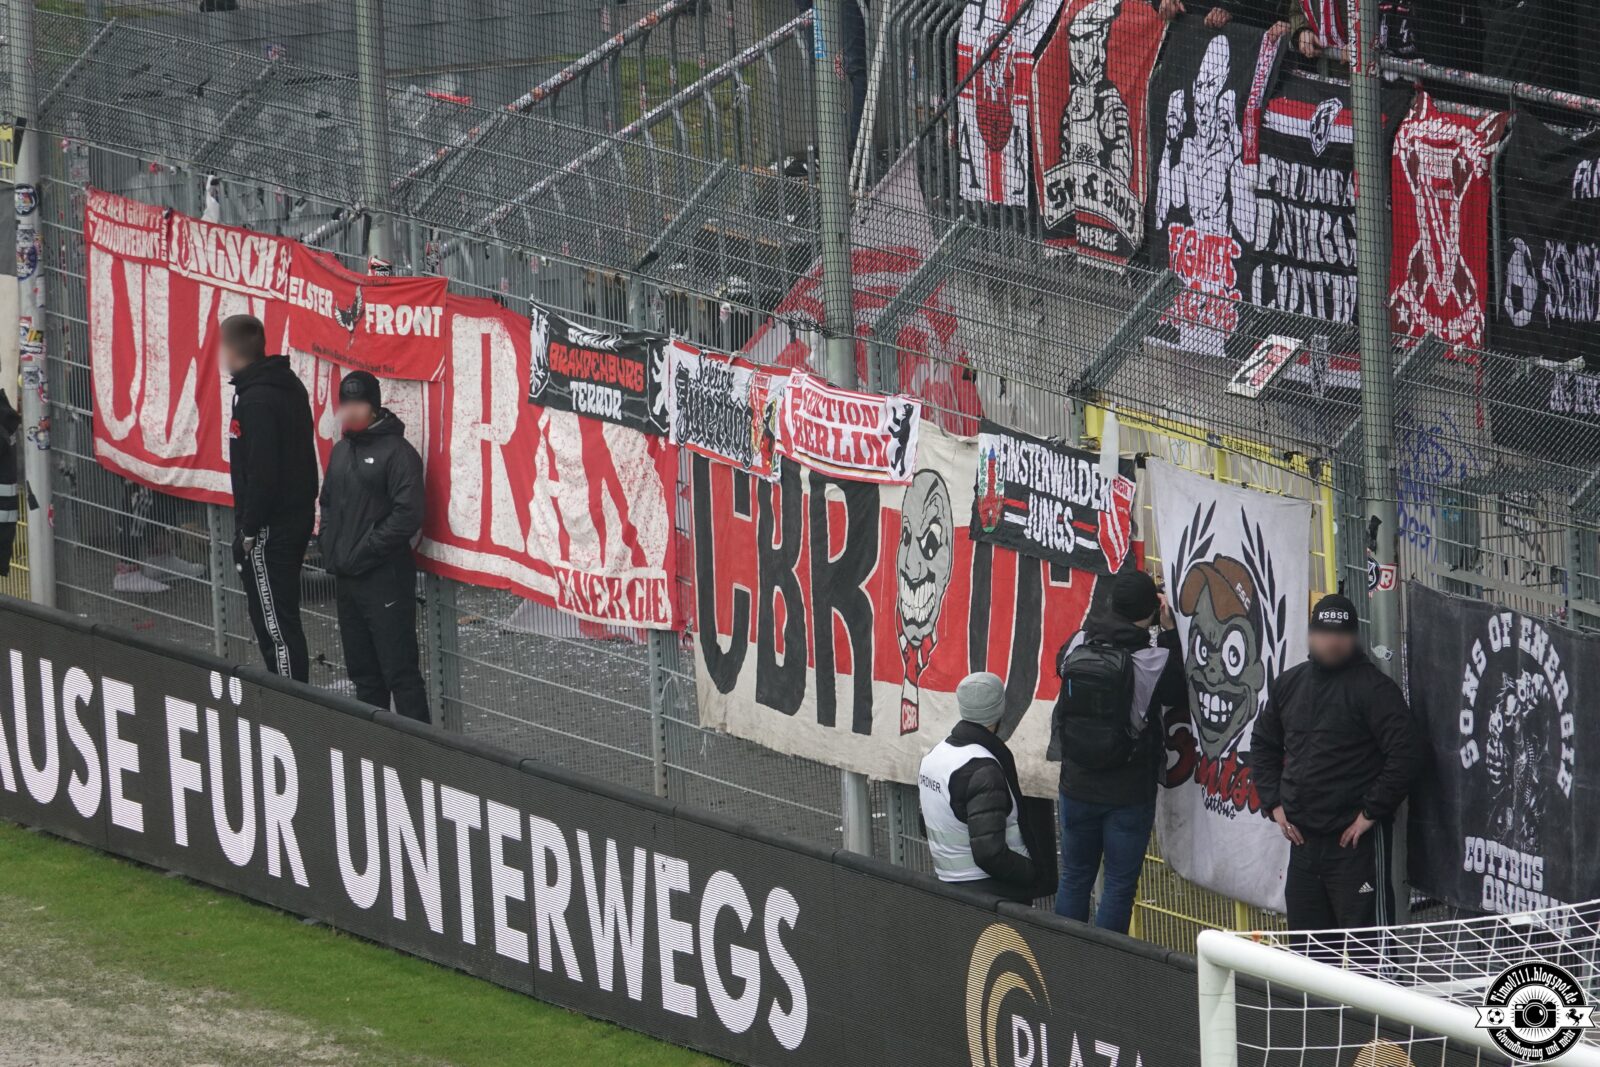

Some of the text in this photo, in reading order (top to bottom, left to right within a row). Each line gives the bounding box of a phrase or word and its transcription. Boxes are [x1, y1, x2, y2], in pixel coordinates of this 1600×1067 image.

[289, 276, 443, 337] ELSTER FRONT
[549, 342, 645, 392] BRANDENBURG
[570, 381, 622, 420] TERROR
[801, 388, 880, 429] SEKTION
[793, 415, 892, 467] BERLIN
[999, 434, 1111, 514] FINSTERWALDER
[1024, 493, 1076, 554] JUNGS
[555, 568, 668, 624] ENERGIE
[1488, 612, 1512, 653] OF
[901, 703, 918, 729] CBR
[919, 774, 942, 794] ORDNER
[165, 670, 310, 888] FÜR
[330, 747, 808, 1051] UNTERWEGS
[1464, 836, 1543, 891] COTTBUS
